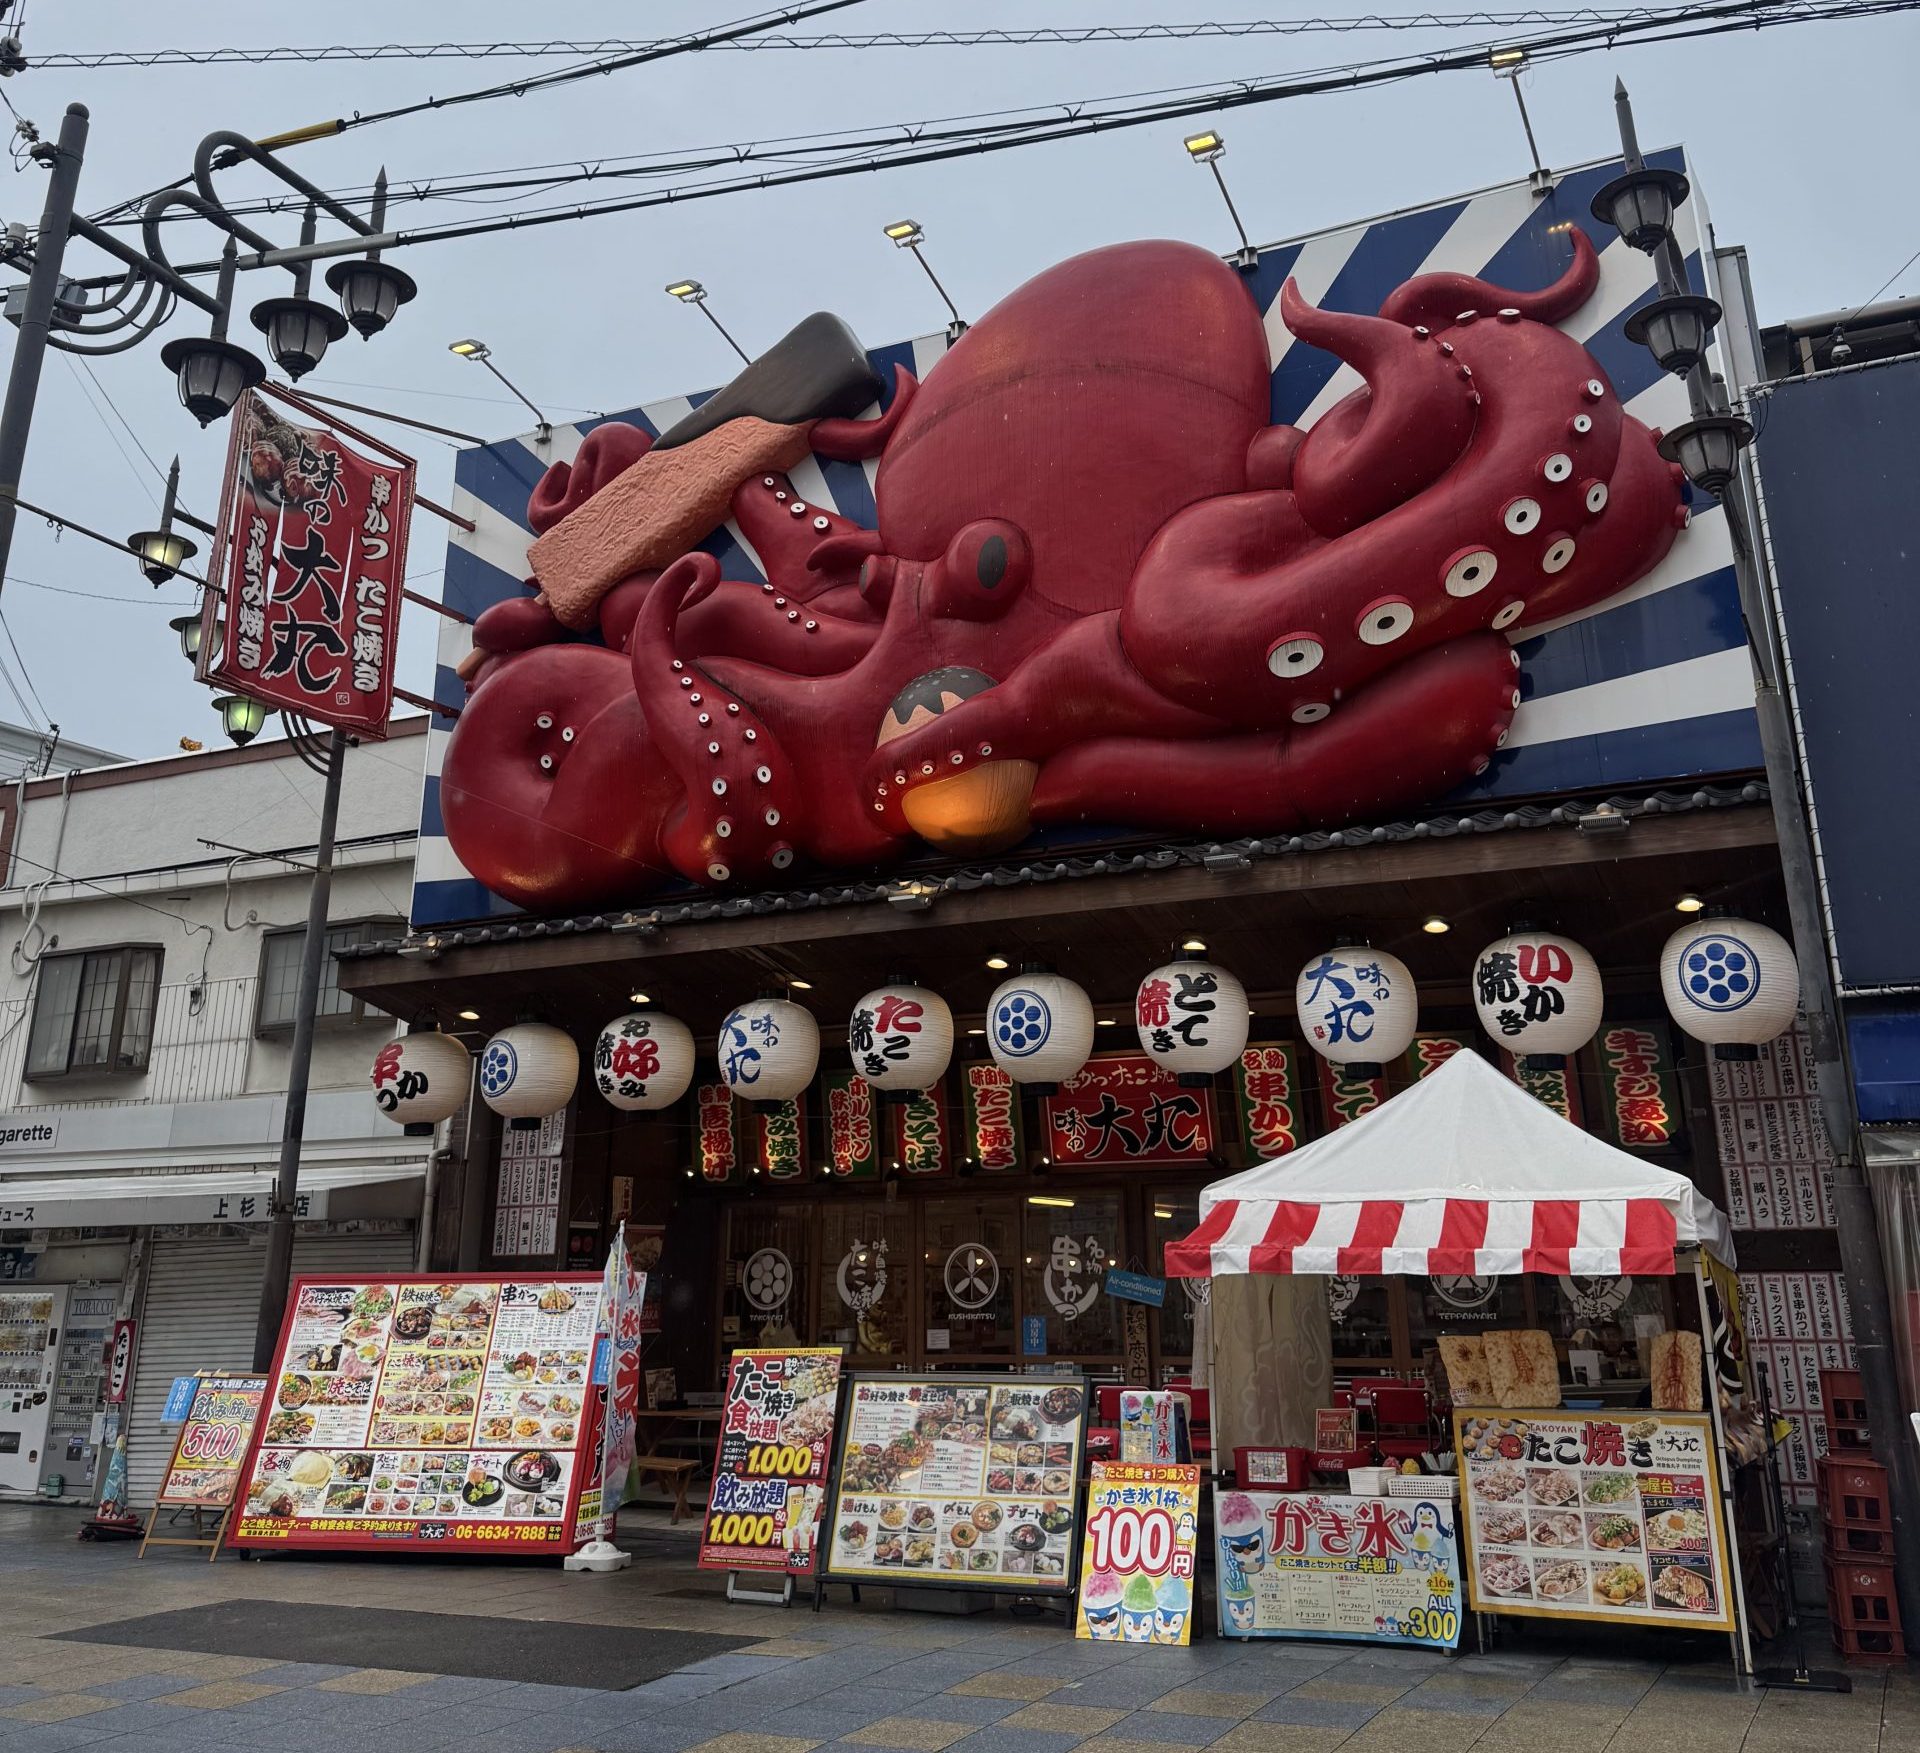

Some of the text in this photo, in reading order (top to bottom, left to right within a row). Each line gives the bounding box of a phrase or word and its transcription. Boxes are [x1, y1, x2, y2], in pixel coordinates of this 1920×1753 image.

[237, 514, 268, 671] お好み焼き
[352, 472, 392, 692] 串かつ たこ焼き
[1304, 956, 1375, 1046] 大丸
[1354, 963, 1391, 1000] 味の
[1518, 944, 1574, 1022] いか
[719, 1009, 762, 1087] 大丸
[873, 995, 924, 1060] たこ
[1241, 1047, 1287, 1071] 名物
[0, 1124, 53, 1145] garette
[829, 1088, 854, 1177] 鉄板焼き
[849, 1075, 872, 1162] ホルモン
[904, 1090, 943, 1173] きそば
[973, 1088, 1016, 1169] たこ焼き
[1052, 1091, 1201, 1159] 味の 大丸
[1245, 1071, 1296, 1160] 串かつ
[700, 1105, 736, 1181] 唐揚げ
[1753, 1182, 1770, 1219] 豚バラ
[1798, 1176, 1817, 1223] ホルモン
[301, 1288, 351, 1305] お好み焼き
[401, 1287, 443, 1303] 鉄板焼き
[500, 1283, 539, 1305] 串かつ
[1050, 1234, 1084, 1322] 串かつ
[1108, 1275, 1163, 1297] Air-conditioned
[948, 1313, 996, 1321] KUSHIKATSU
[1439, 1312, 1498, 1321] TEPPANYAKI
[1768, 1283, 1787, 1337] ミックス玉
[113, 1331, 128, 1388] たばこ
[386, 1353, 422, 1369] たこ焼き
[1779, 1355, 1797, 1404] サーモン
[1803, 1355, 1820, 1405] たこ焼き
[190, 1392, 257, 1422] 飲み放題
[327, 1376, 374, 1395] 焼きそば
[1153, 1400, 1173, 1461] かき氷
[1525, 1419, 1655, 1469] たこ焼き
[1528, 1422, 1578, 1434] TAKOYAKI
[262, 1451, 292, 1472] 名物
[712, 1472, 788, 1512] 飲み放題
[1106, 1486, 1181, 1509] かき氷1杯
[1647, 1477, 1703, 1495] 屋台メニュー
[1265, 1498, 1408, 1557] かき氷
[1397, 1606, 1457, 1642] ¥300
[1428, 1593, 1456, 1612] ALL
